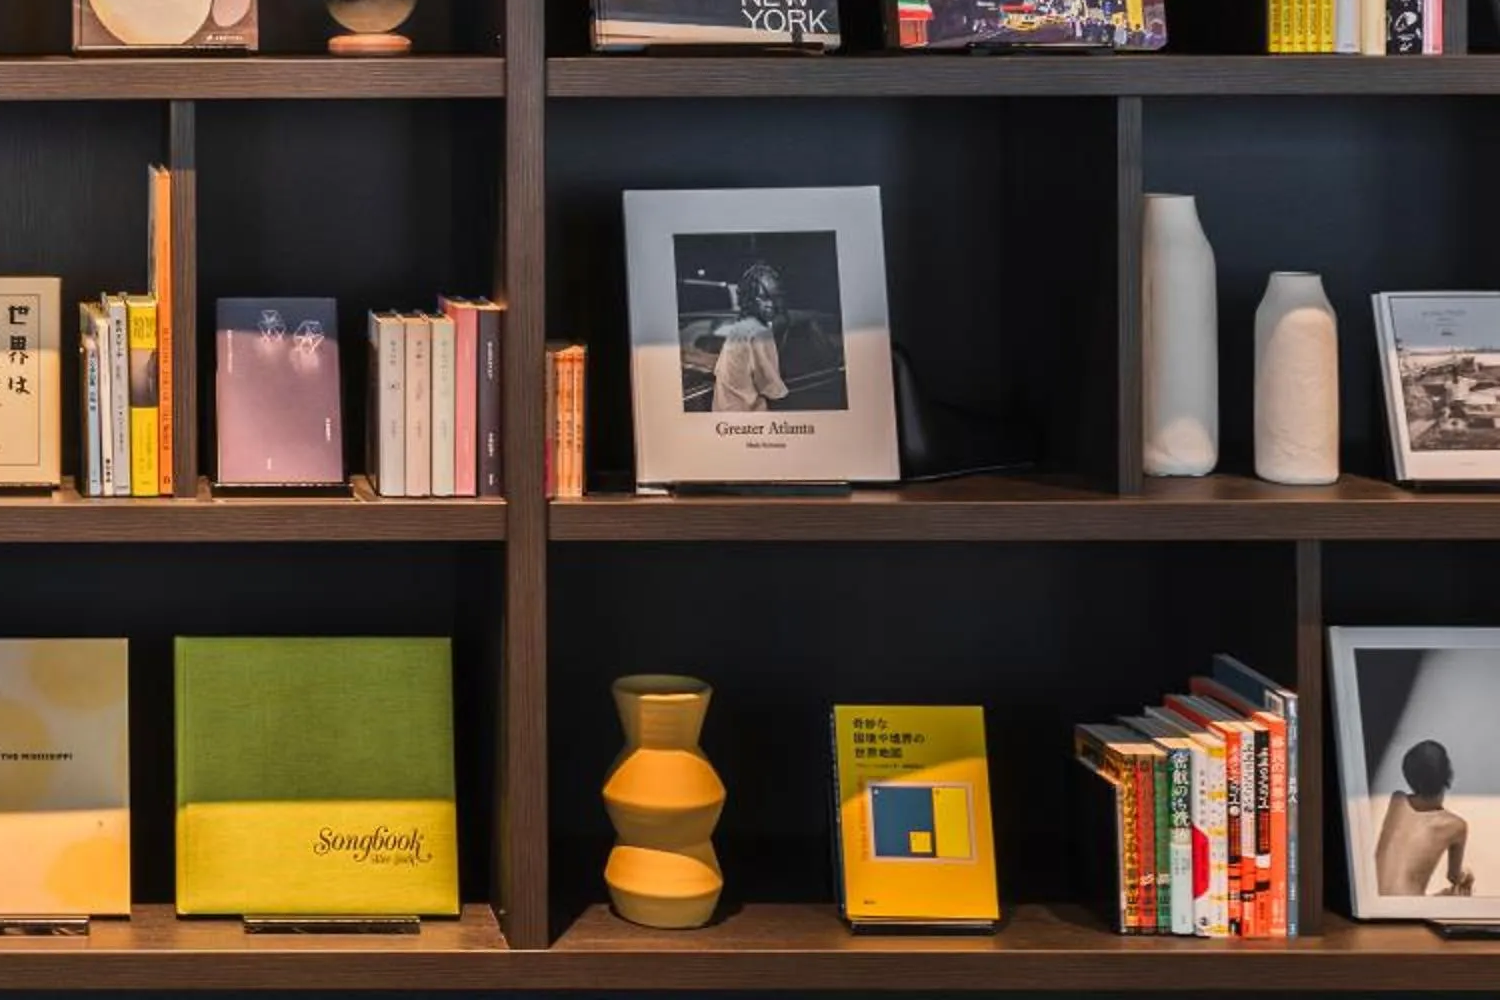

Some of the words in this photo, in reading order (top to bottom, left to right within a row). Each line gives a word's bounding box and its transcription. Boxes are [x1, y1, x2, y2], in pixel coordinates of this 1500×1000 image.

[741, 8, 829, 34] YORK
[8, 304, 31, 395] 世界は
[715, 421, 764, 436] Greater
[769, 420, 816, 435] Atlanta
[313, 825, 433, 862] Songbook
